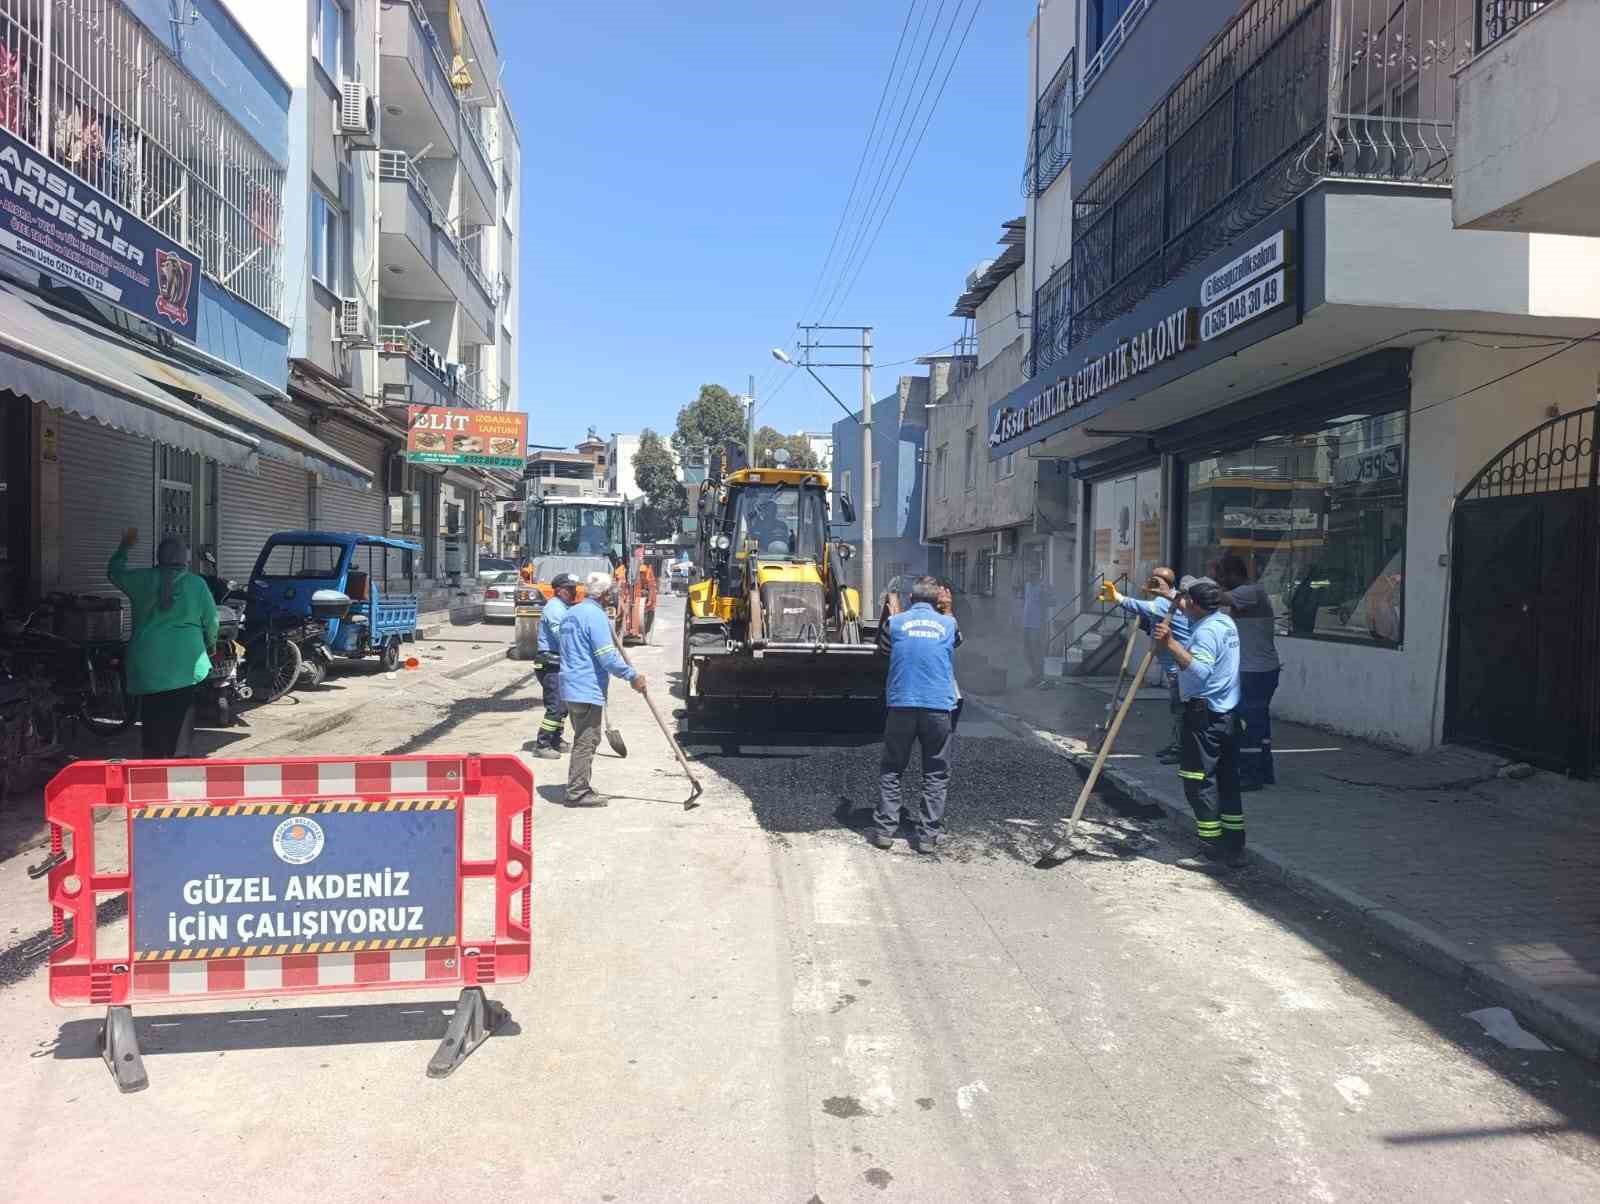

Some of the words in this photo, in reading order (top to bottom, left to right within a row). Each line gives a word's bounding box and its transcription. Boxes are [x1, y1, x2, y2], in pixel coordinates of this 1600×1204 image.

[0, 146, 122, 232] ARSLAN
[38, 248, 54, 266] Usta
[1248, 287, 1261, 314] 30
[988, 407, 1024, 447] Lissa
[1027, 376, 1066, 427] GELİNLİK
[1075, 338, 1128, 402] GÜZELLİK
[1130, 307, 1189, 375] SALONU
[413, 410, 469, 431] ELİT
[183, 873, 276, 905] GÜZEL
[284, 867, 410, 901] AKDENİZ
[168, 911, 228, 946] İÇİN
[236, 906, 424, 943] ÇALIŞIYORUZ
